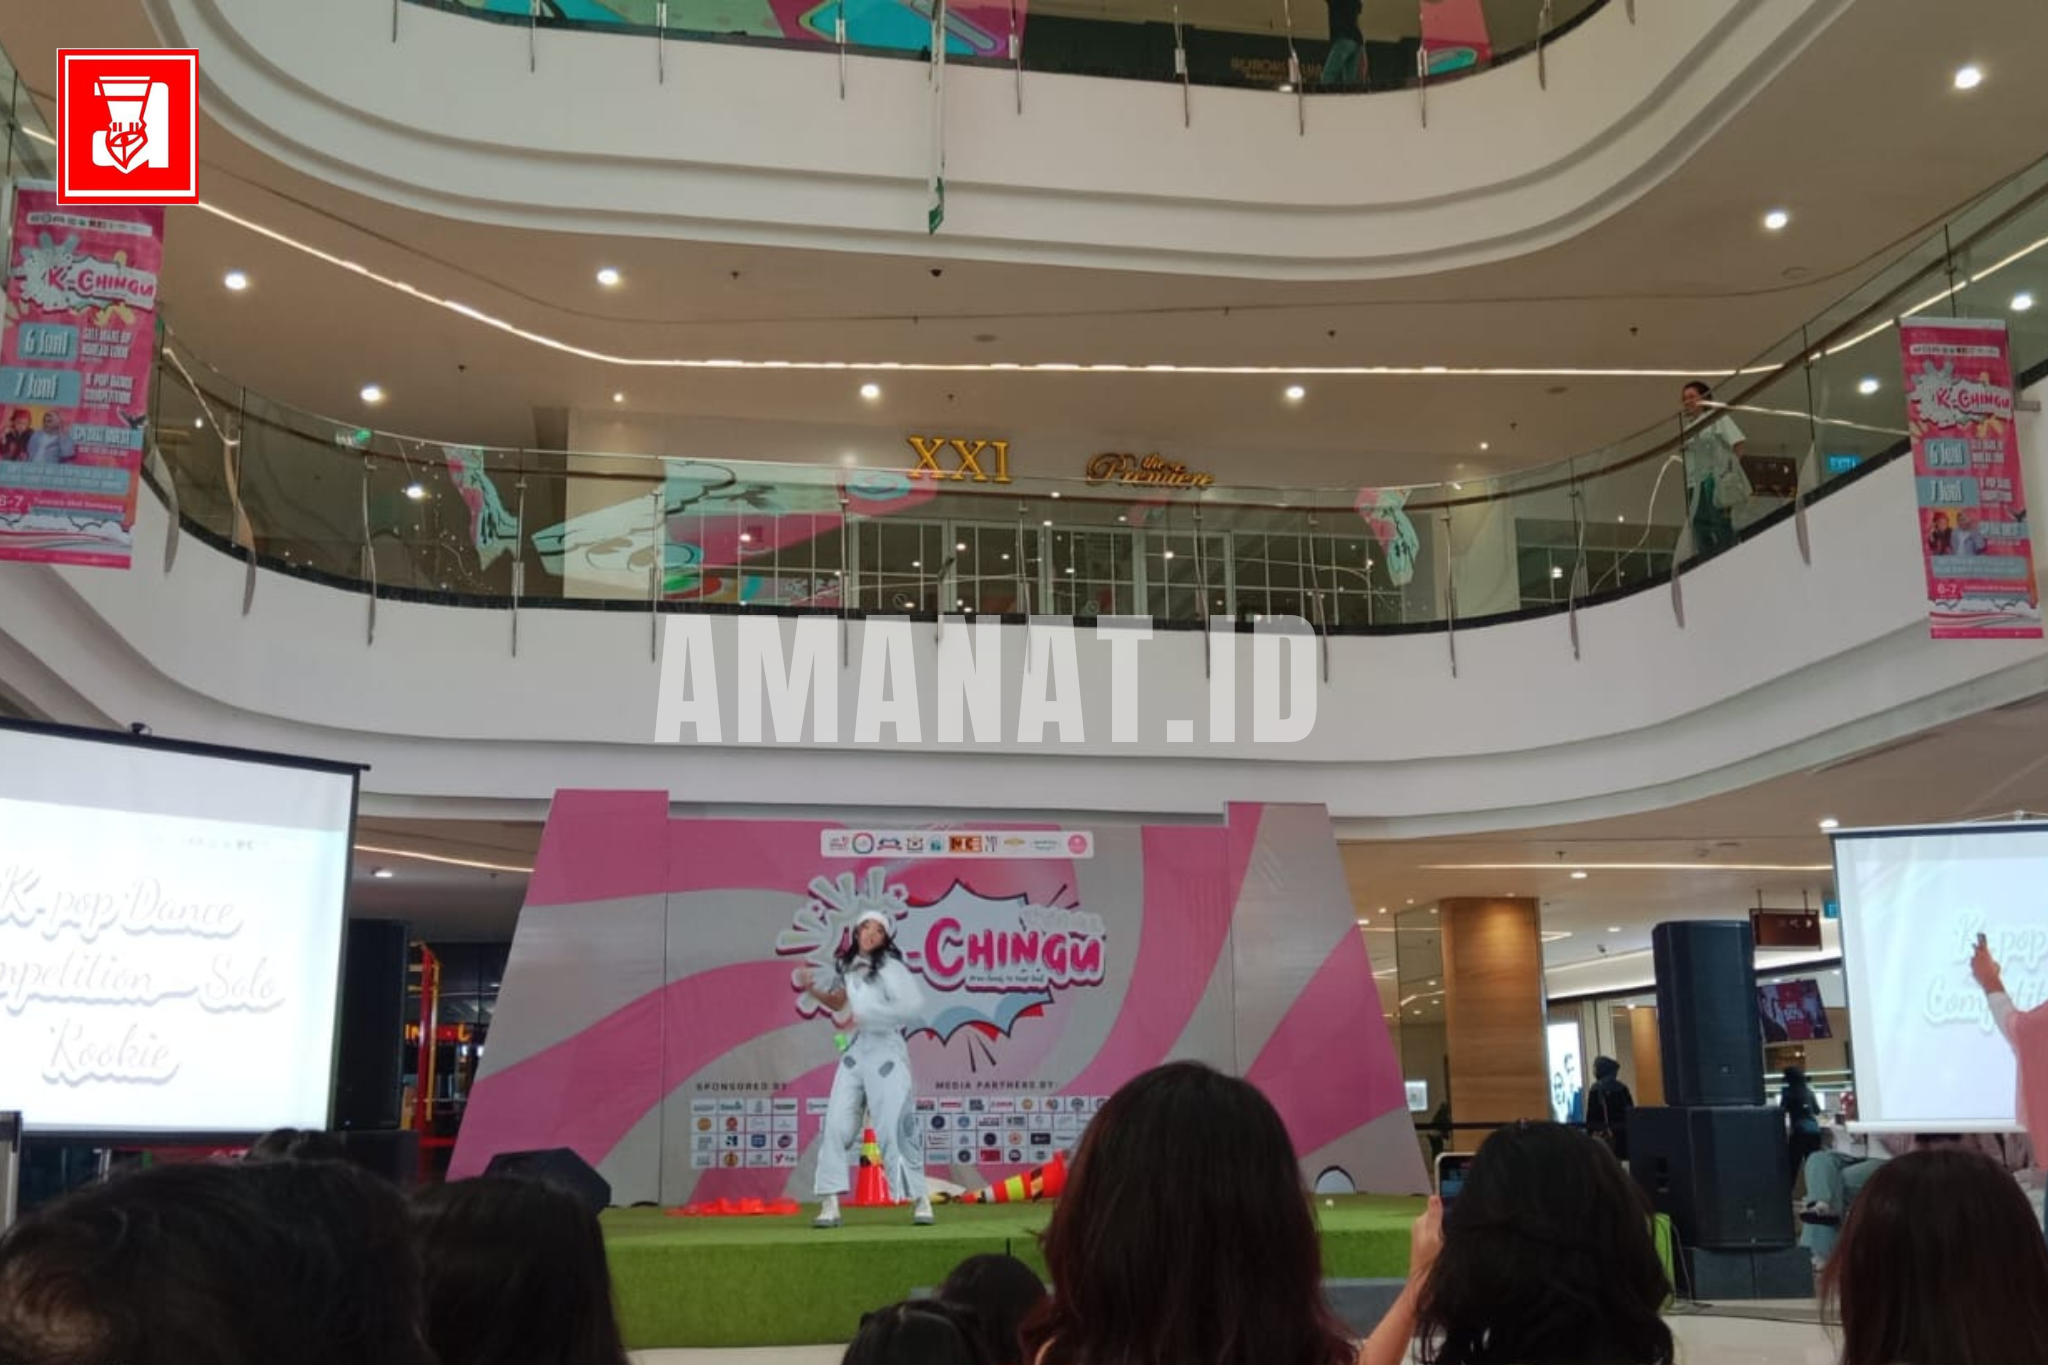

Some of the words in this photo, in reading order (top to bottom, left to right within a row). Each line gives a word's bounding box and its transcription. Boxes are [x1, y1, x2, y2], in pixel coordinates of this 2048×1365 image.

[907, 435, 1012, 484] XXI
[125, 876, 238, 931] Dance
[205, 954, 280, 1006] Solo
[46, 1019, 174, 1077] Rookie
[935, 1081, 972, 1089] MEDIA
[976, 1081, 1036, 1090] PARTNERS
